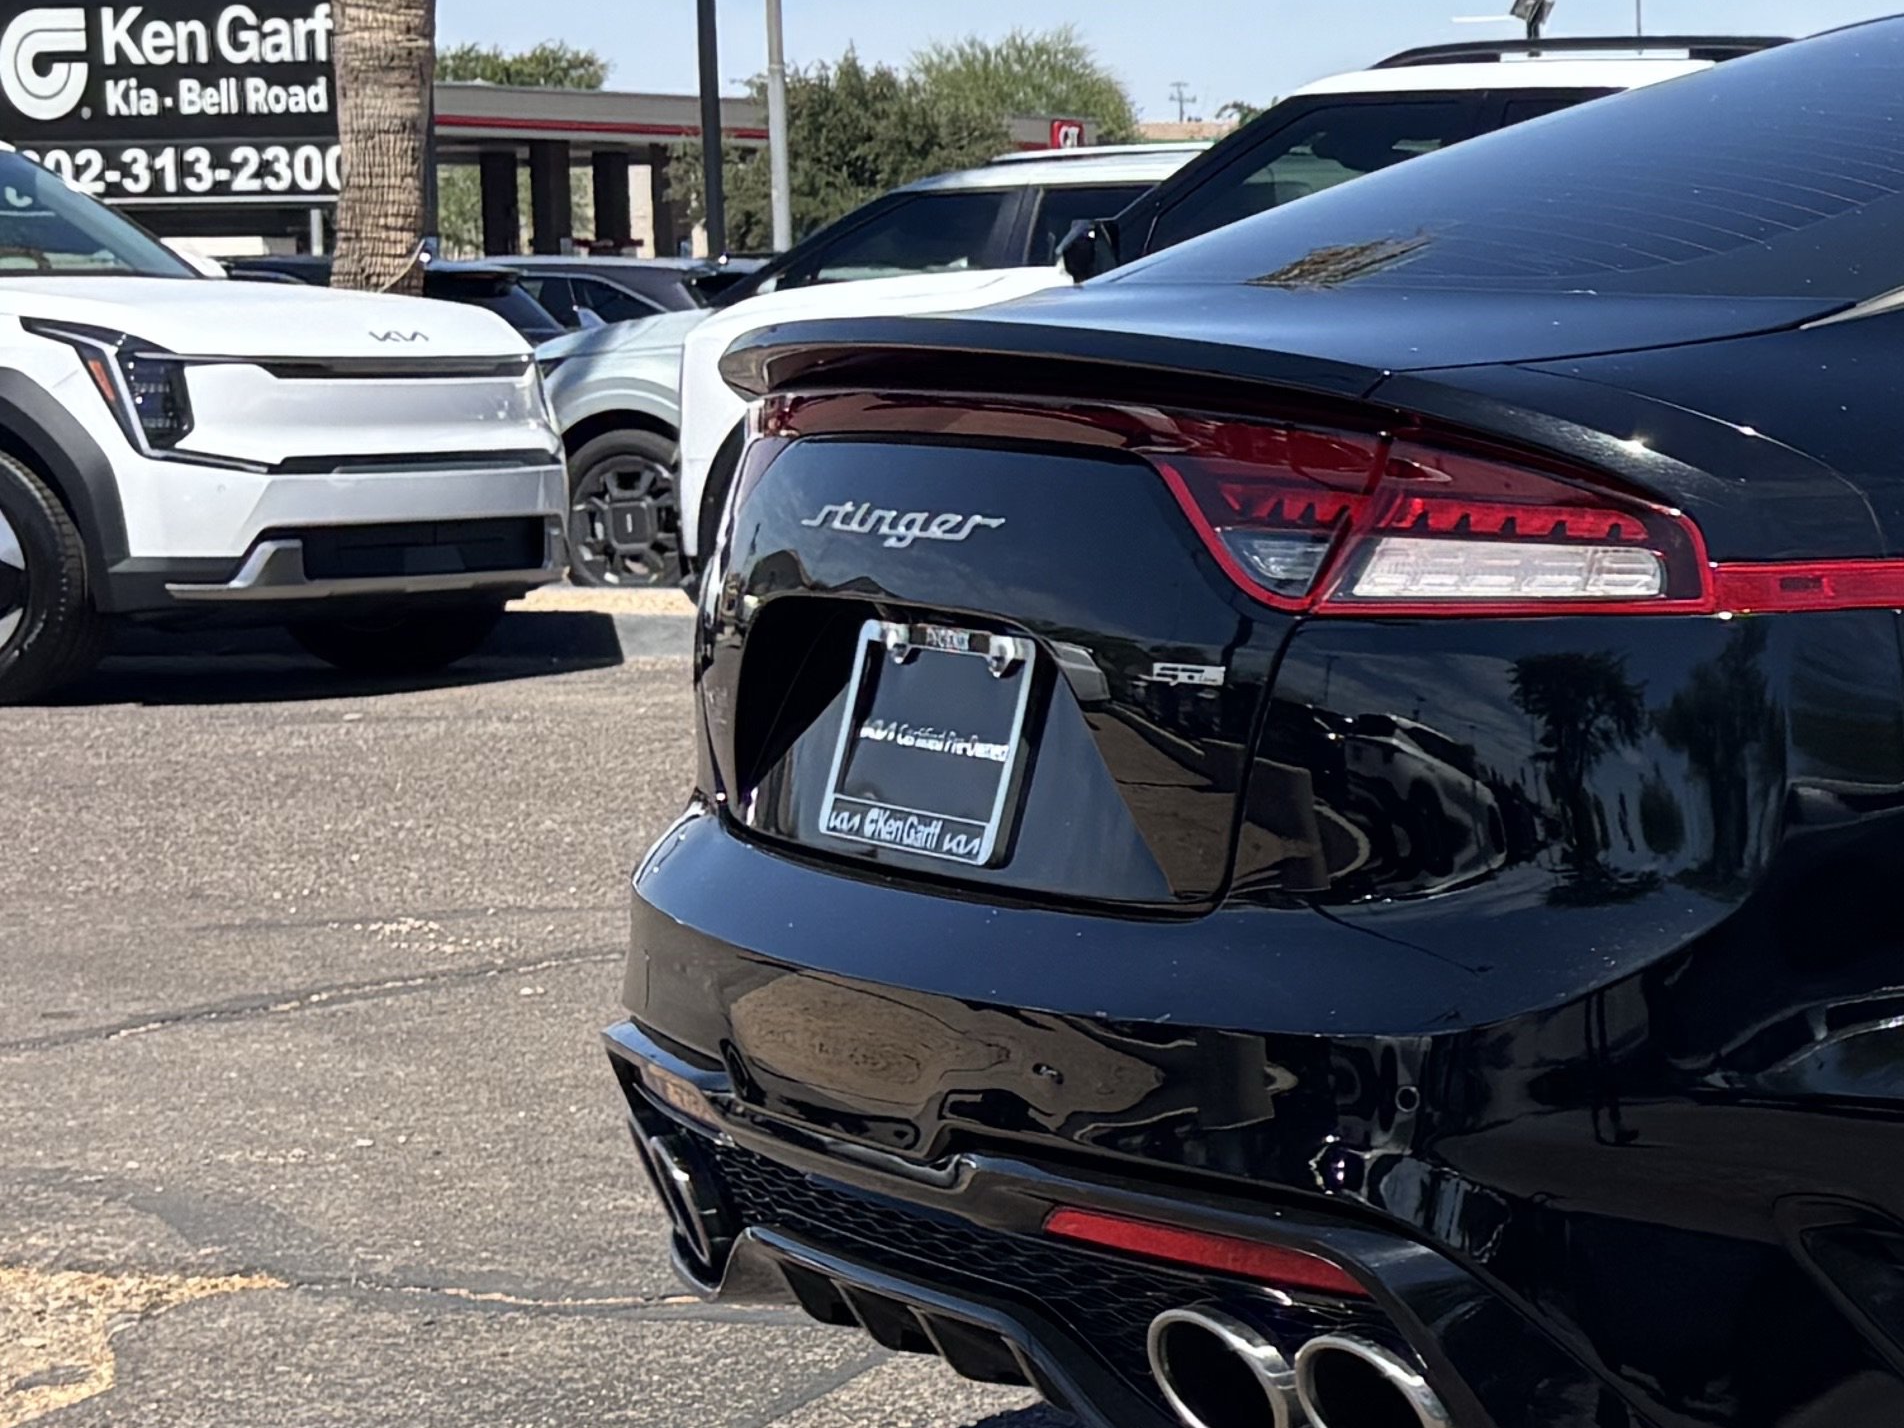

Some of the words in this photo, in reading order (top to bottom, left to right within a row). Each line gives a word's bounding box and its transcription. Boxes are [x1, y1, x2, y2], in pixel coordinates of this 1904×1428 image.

[101, 6, 209, 66] Ken
[216, 3, 334, 65] Garf
[105, 77, 158, 117] Kia
[178, 77, 239, 116] Bell
[246, 76, 328, 115] Road
[22, 144, 342, 194] 02-313-2300
[801, 501, 1005, 549] stinger
[876, 811, 902, 844] Ken
